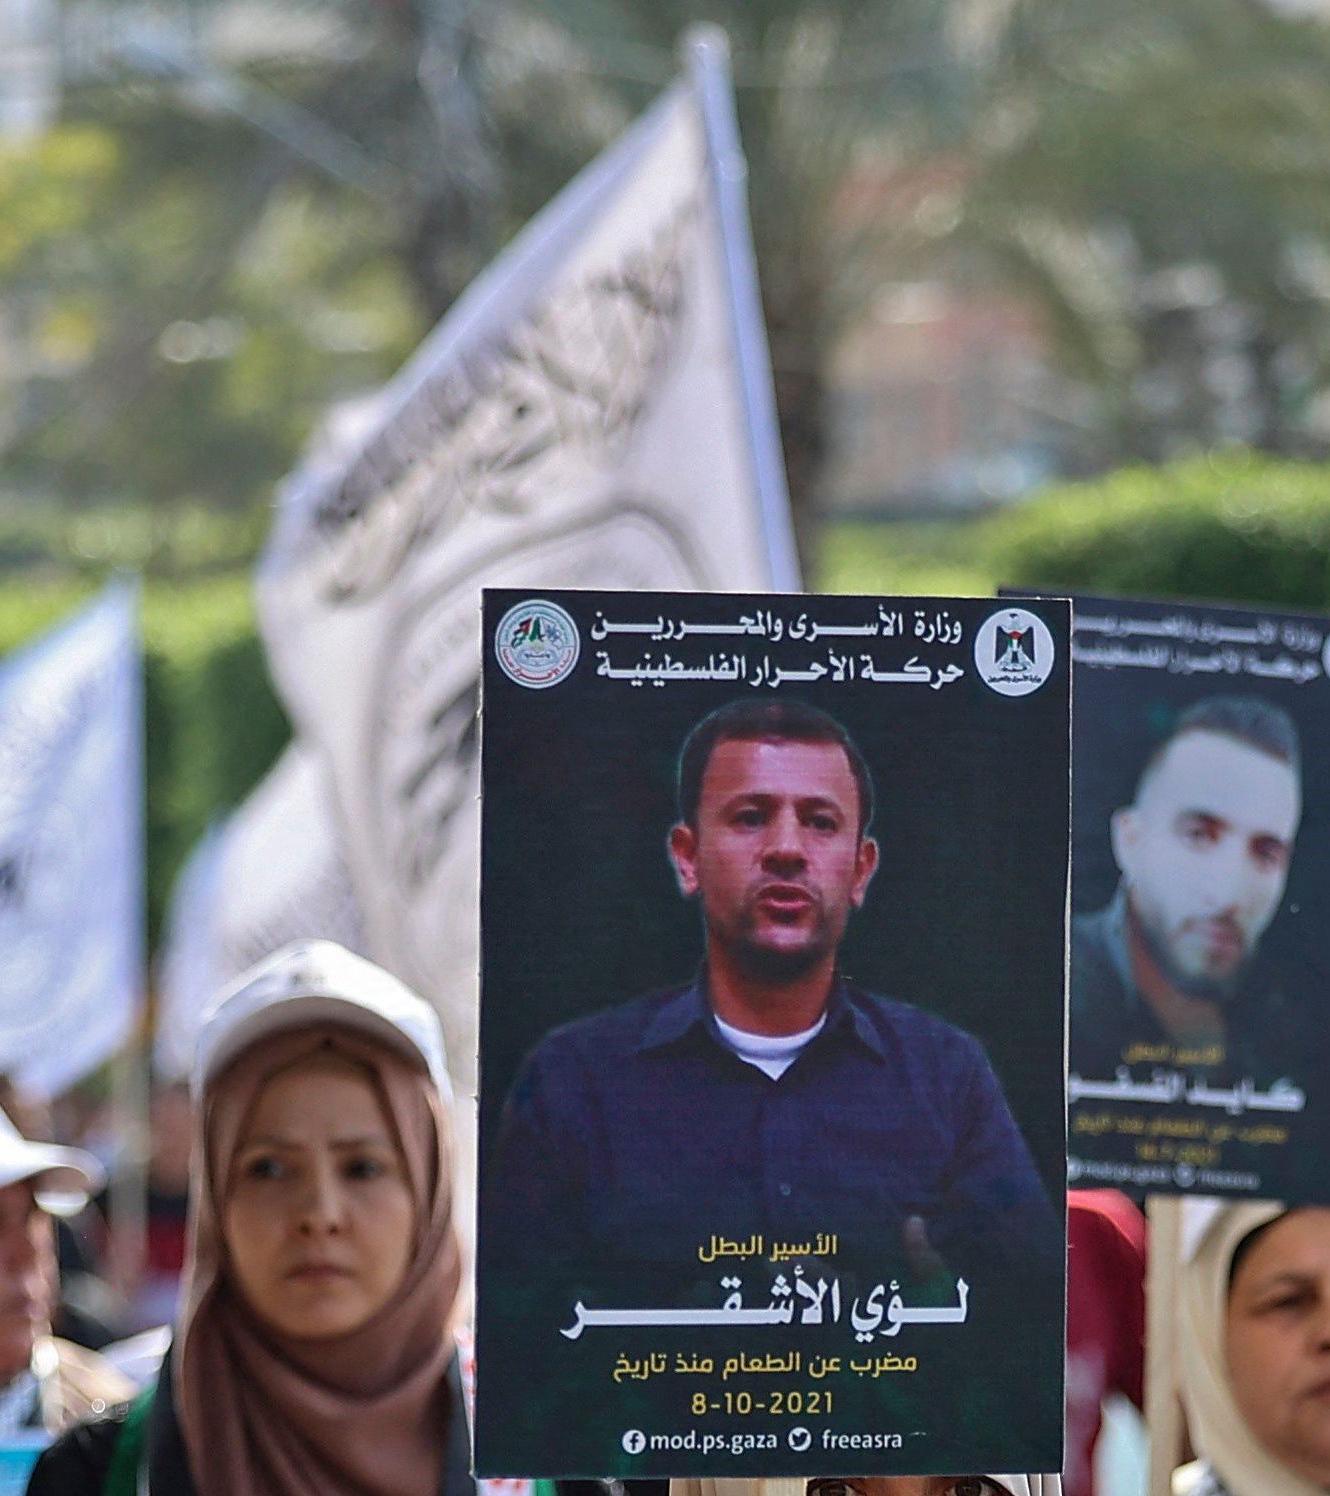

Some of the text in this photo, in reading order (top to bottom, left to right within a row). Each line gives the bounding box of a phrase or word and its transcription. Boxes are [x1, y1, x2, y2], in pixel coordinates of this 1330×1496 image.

[590, 603, 963, 645] وزارة الأسرى والمحررين
[595, 648, 965, 690] حركة الأحرار الفلسطينية
[698, 1234, 838, 1262] الأسير البطل
[560, 1264, 969, 1342] لؤي الأشقر
[613, 1351, 918, 1382] مضرب عن الطعام منذ تاريخ
[691, 1392, 834, 1415] 8-10-2021
[650, 1430, 903, 1454] mod.ps.gaza freeasra
